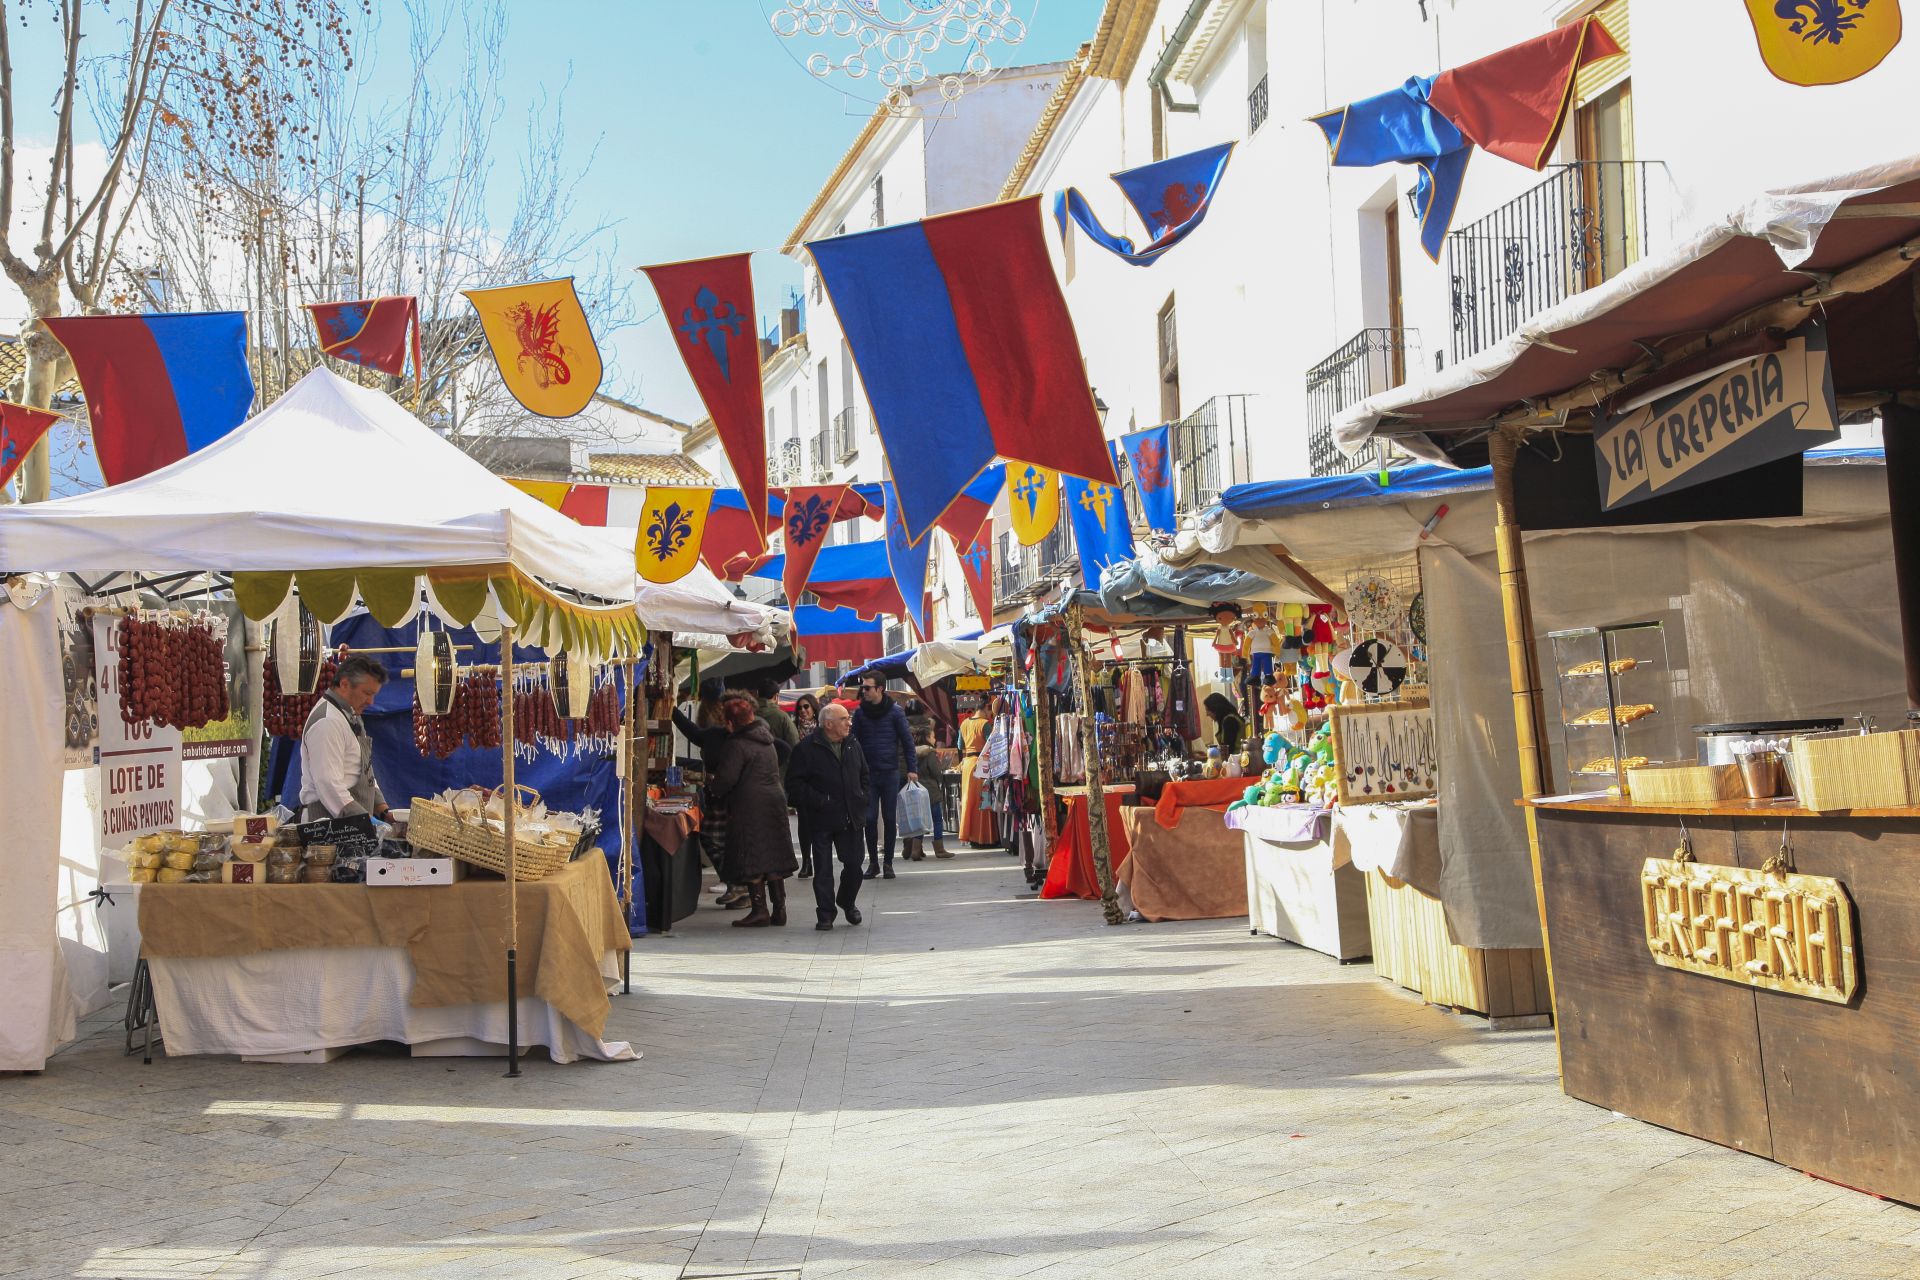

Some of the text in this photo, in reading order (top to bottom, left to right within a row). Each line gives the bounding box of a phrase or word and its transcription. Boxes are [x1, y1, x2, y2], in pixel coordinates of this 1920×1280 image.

[1613, 353, 1784, 481] LA CREPERÍA
[103, 799, 174, 836] 3 CUÑAS PAYOYAS
[109, 763, 165, 795] LOTE DE
[1641, 874, 1846, 999] CREPERIA
